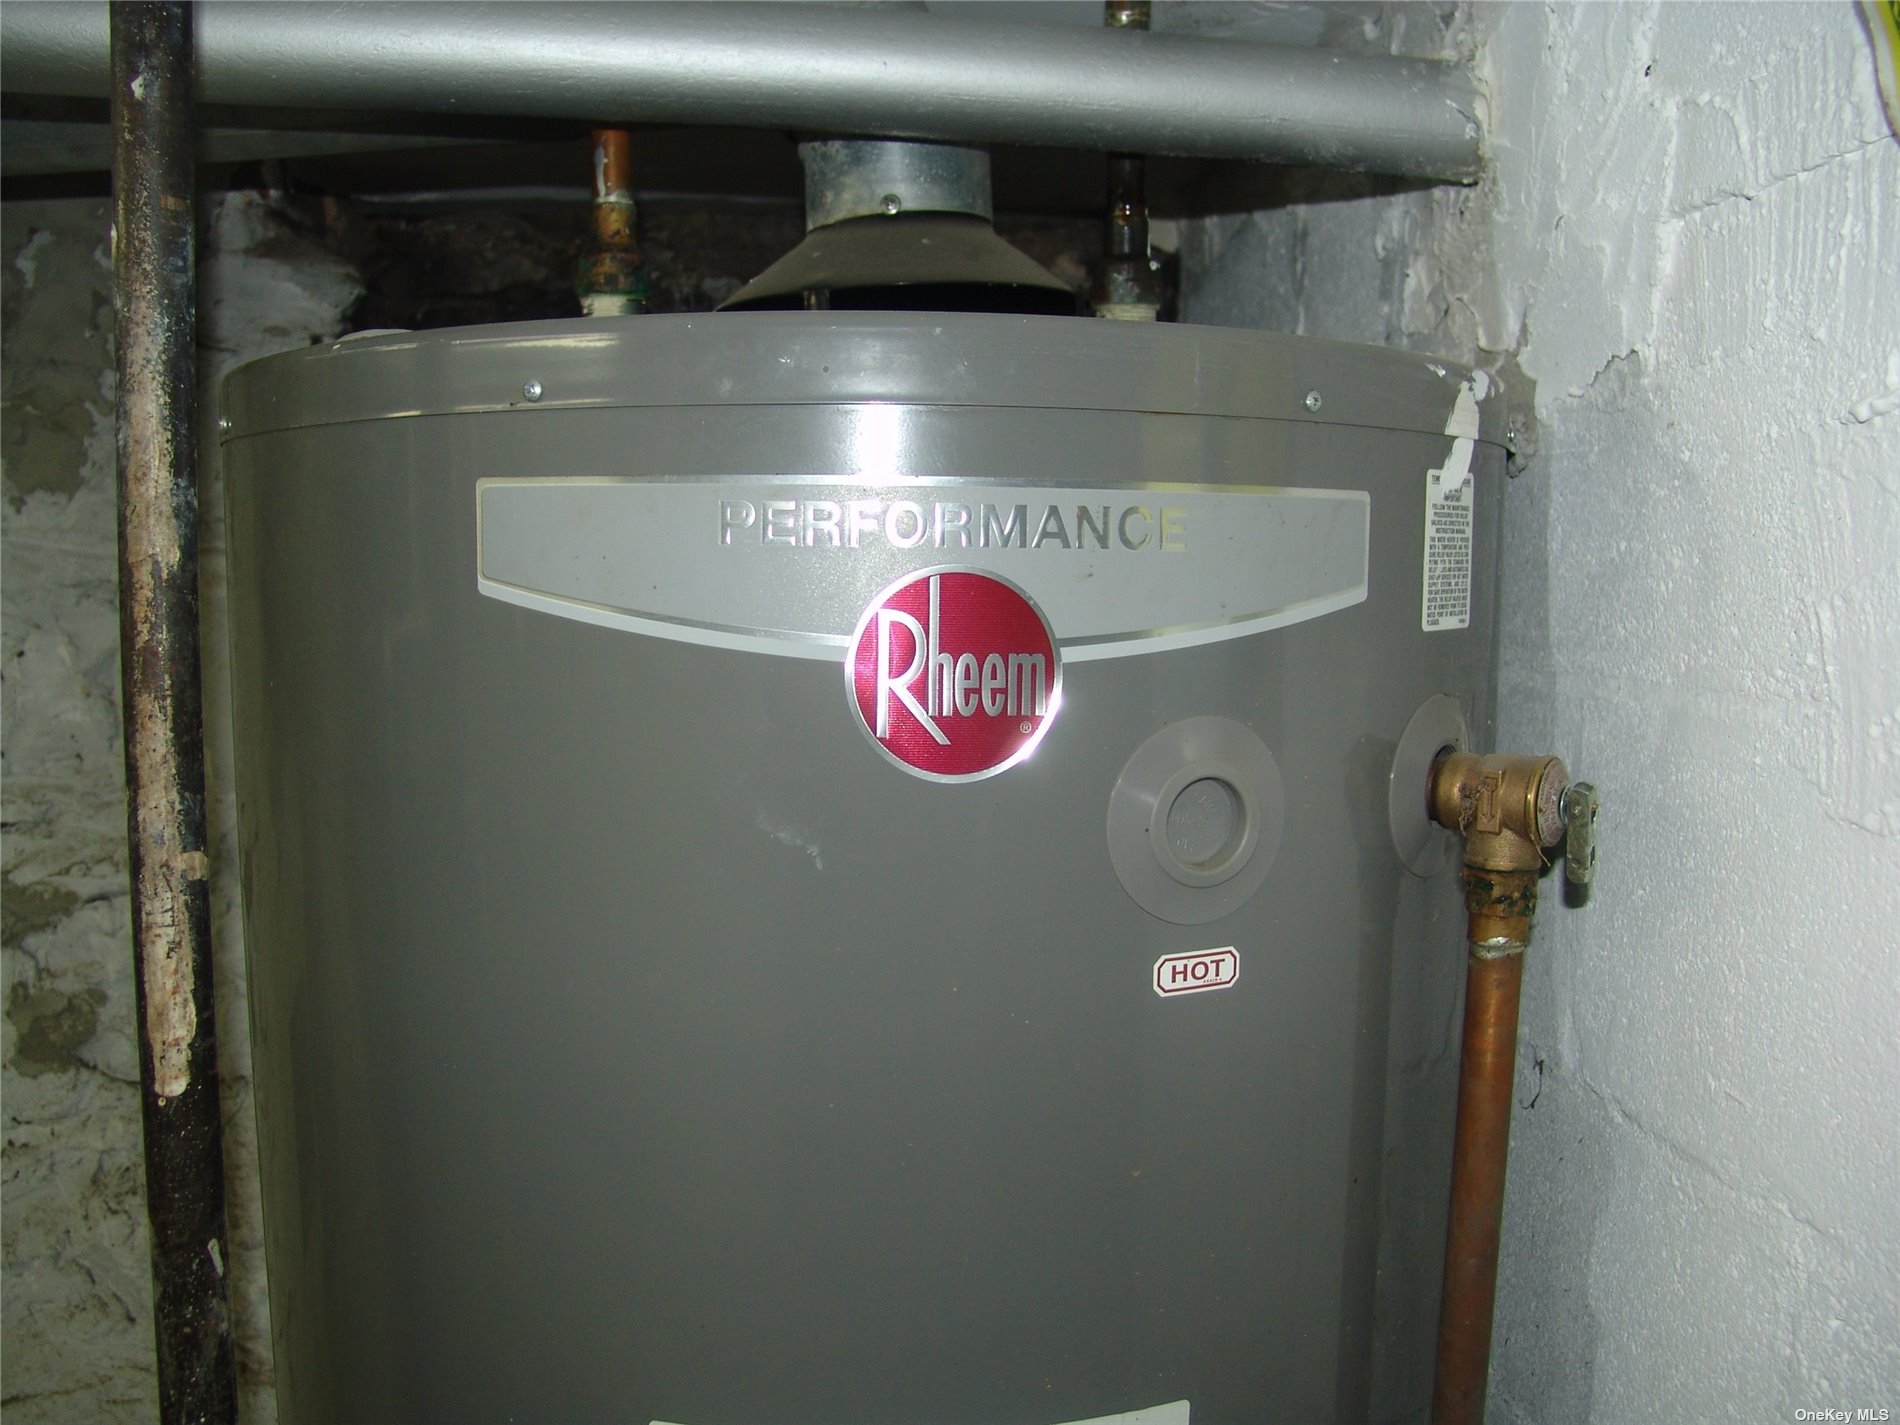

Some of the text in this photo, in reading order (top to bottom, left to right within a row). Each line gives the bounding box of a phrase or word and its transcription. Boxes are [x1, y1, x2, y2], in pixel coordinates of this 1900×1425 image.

[719, 500, 1187, 551] PERFORMANCE
[876, 574, 1047, 745] Rheem
[1171, 958, 1226, 984] HOT
